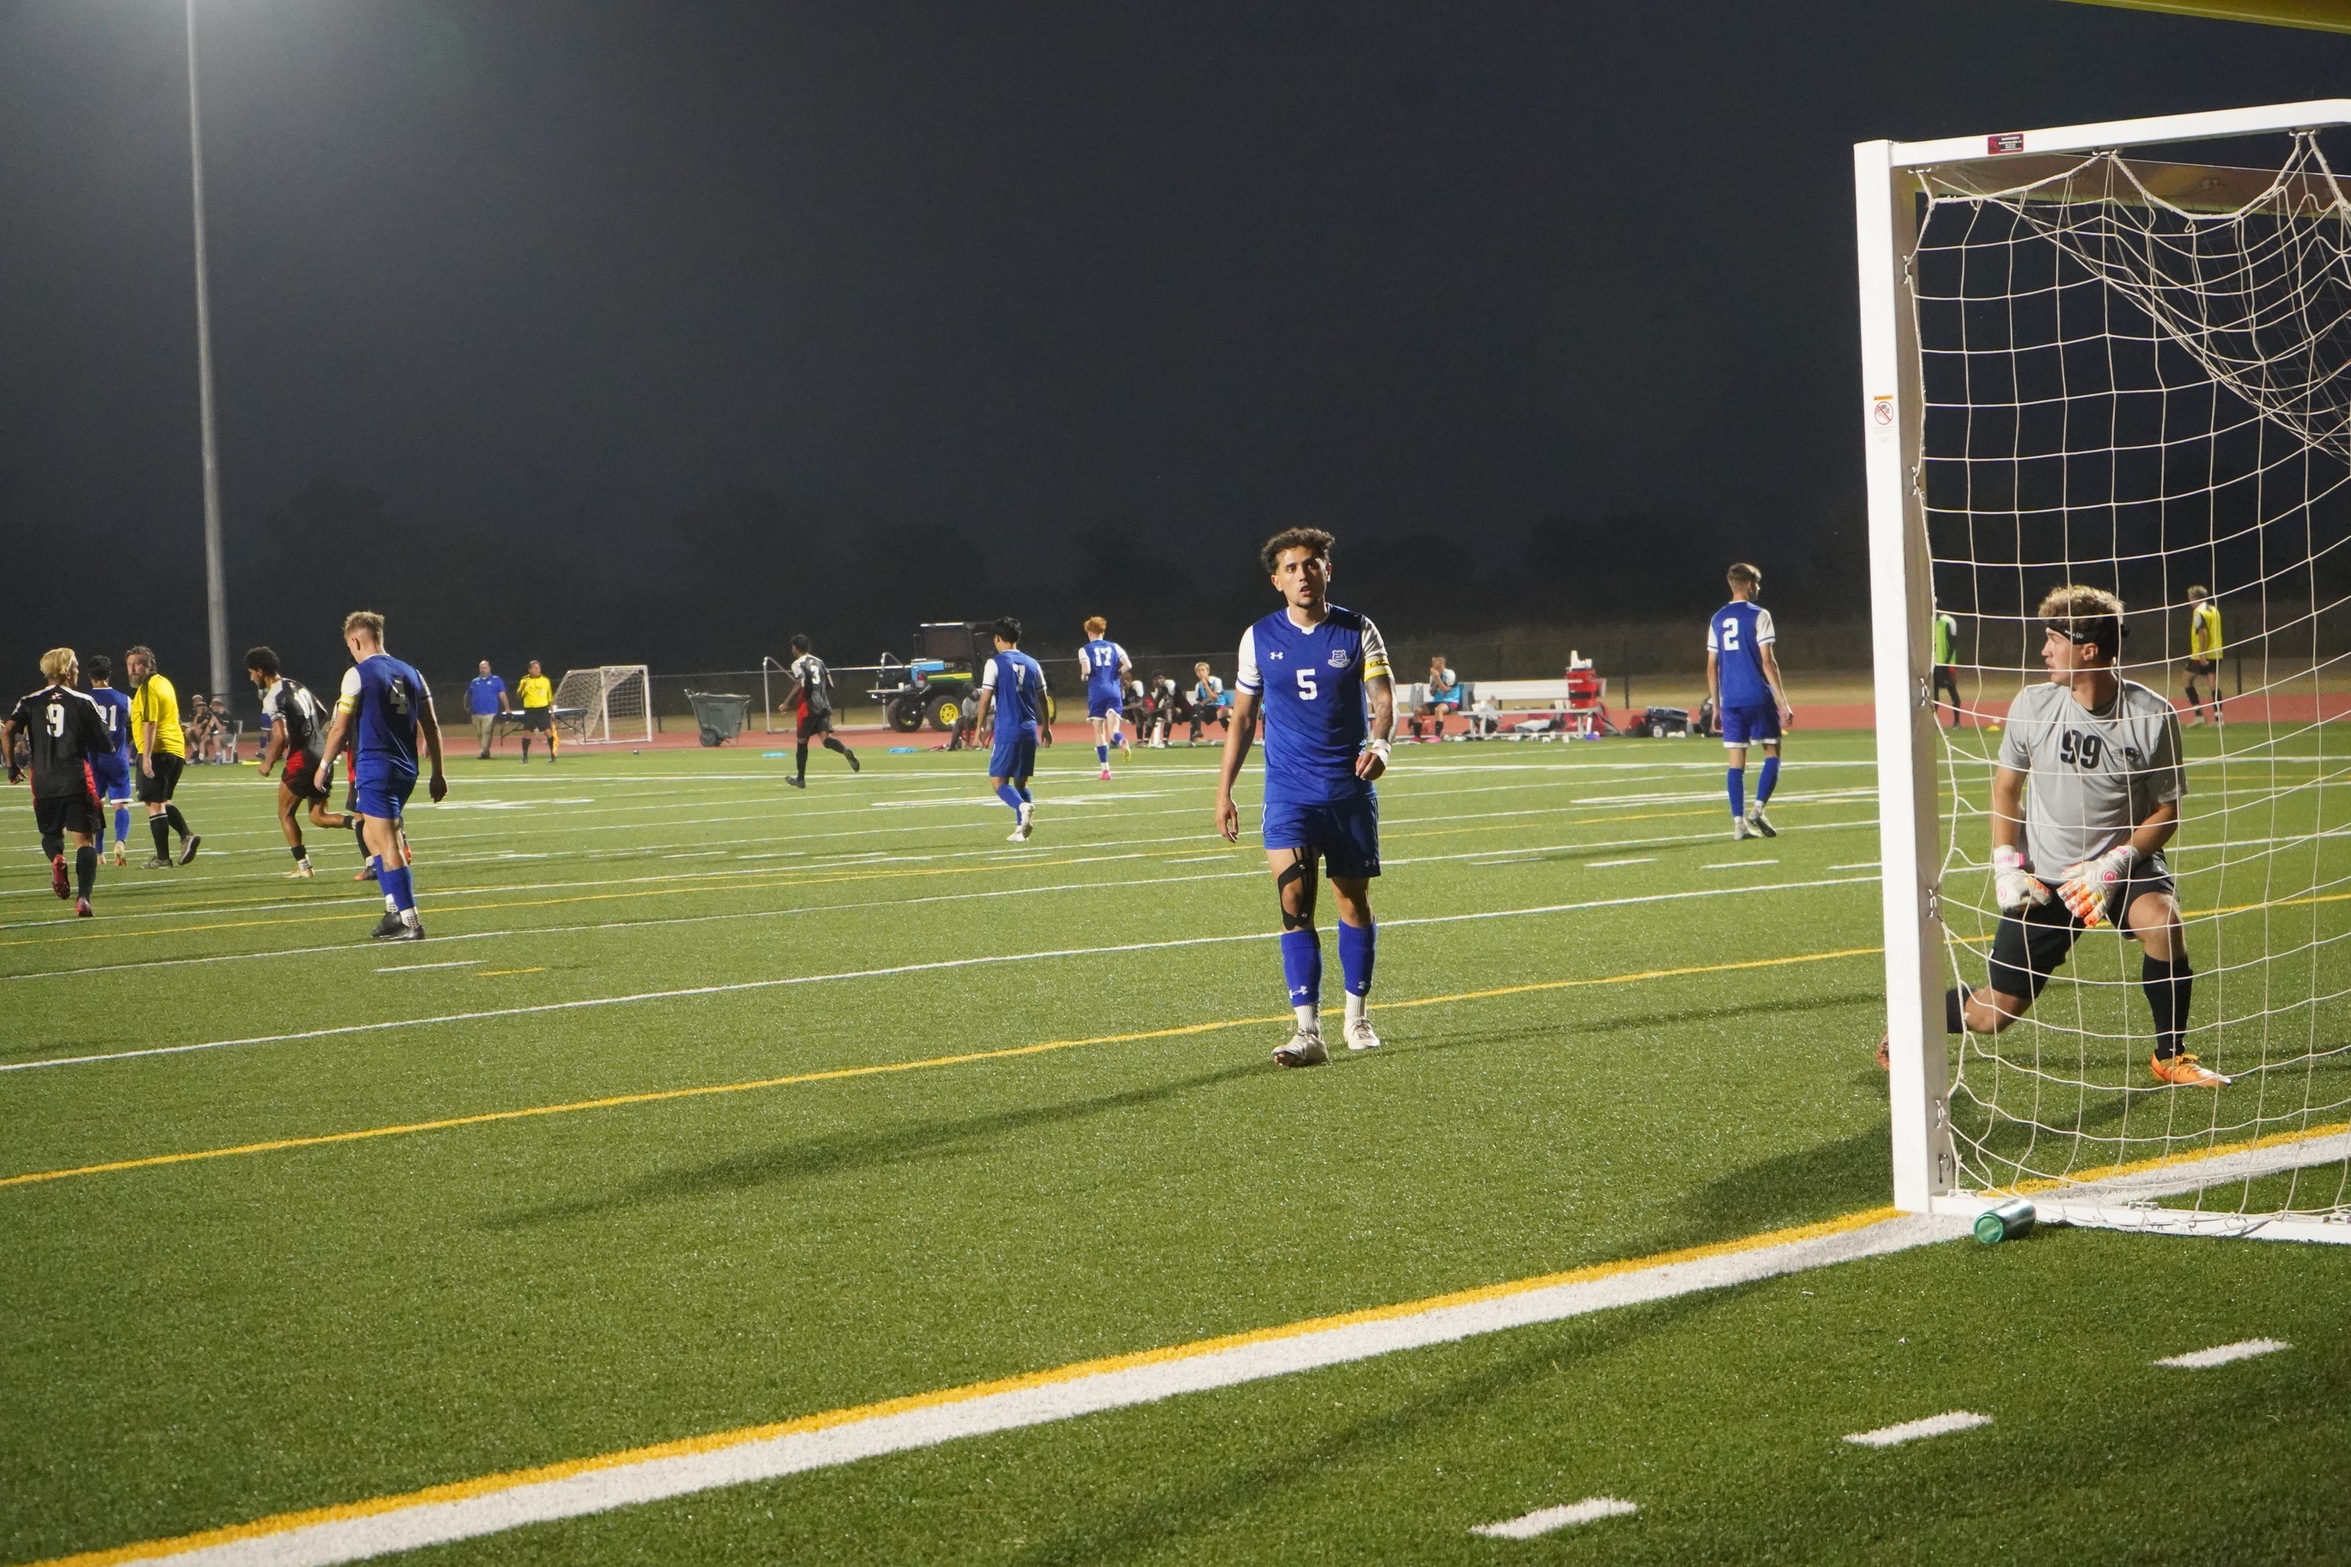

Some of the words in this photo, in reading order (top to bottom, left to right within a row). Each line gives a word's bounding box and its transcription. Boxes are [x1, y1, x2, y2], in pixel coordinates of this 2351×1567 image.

[1722, 617, 1740, 651] 2
[1093, 647, 1112, 667] 17
[810, 665, 821, 684] 3
[1296, 668, 1318, 701] 5
[389, 678, 408, 715] 4
[46, 703, 65, 738] 9
[2060, 729, 2103, 769] 99
